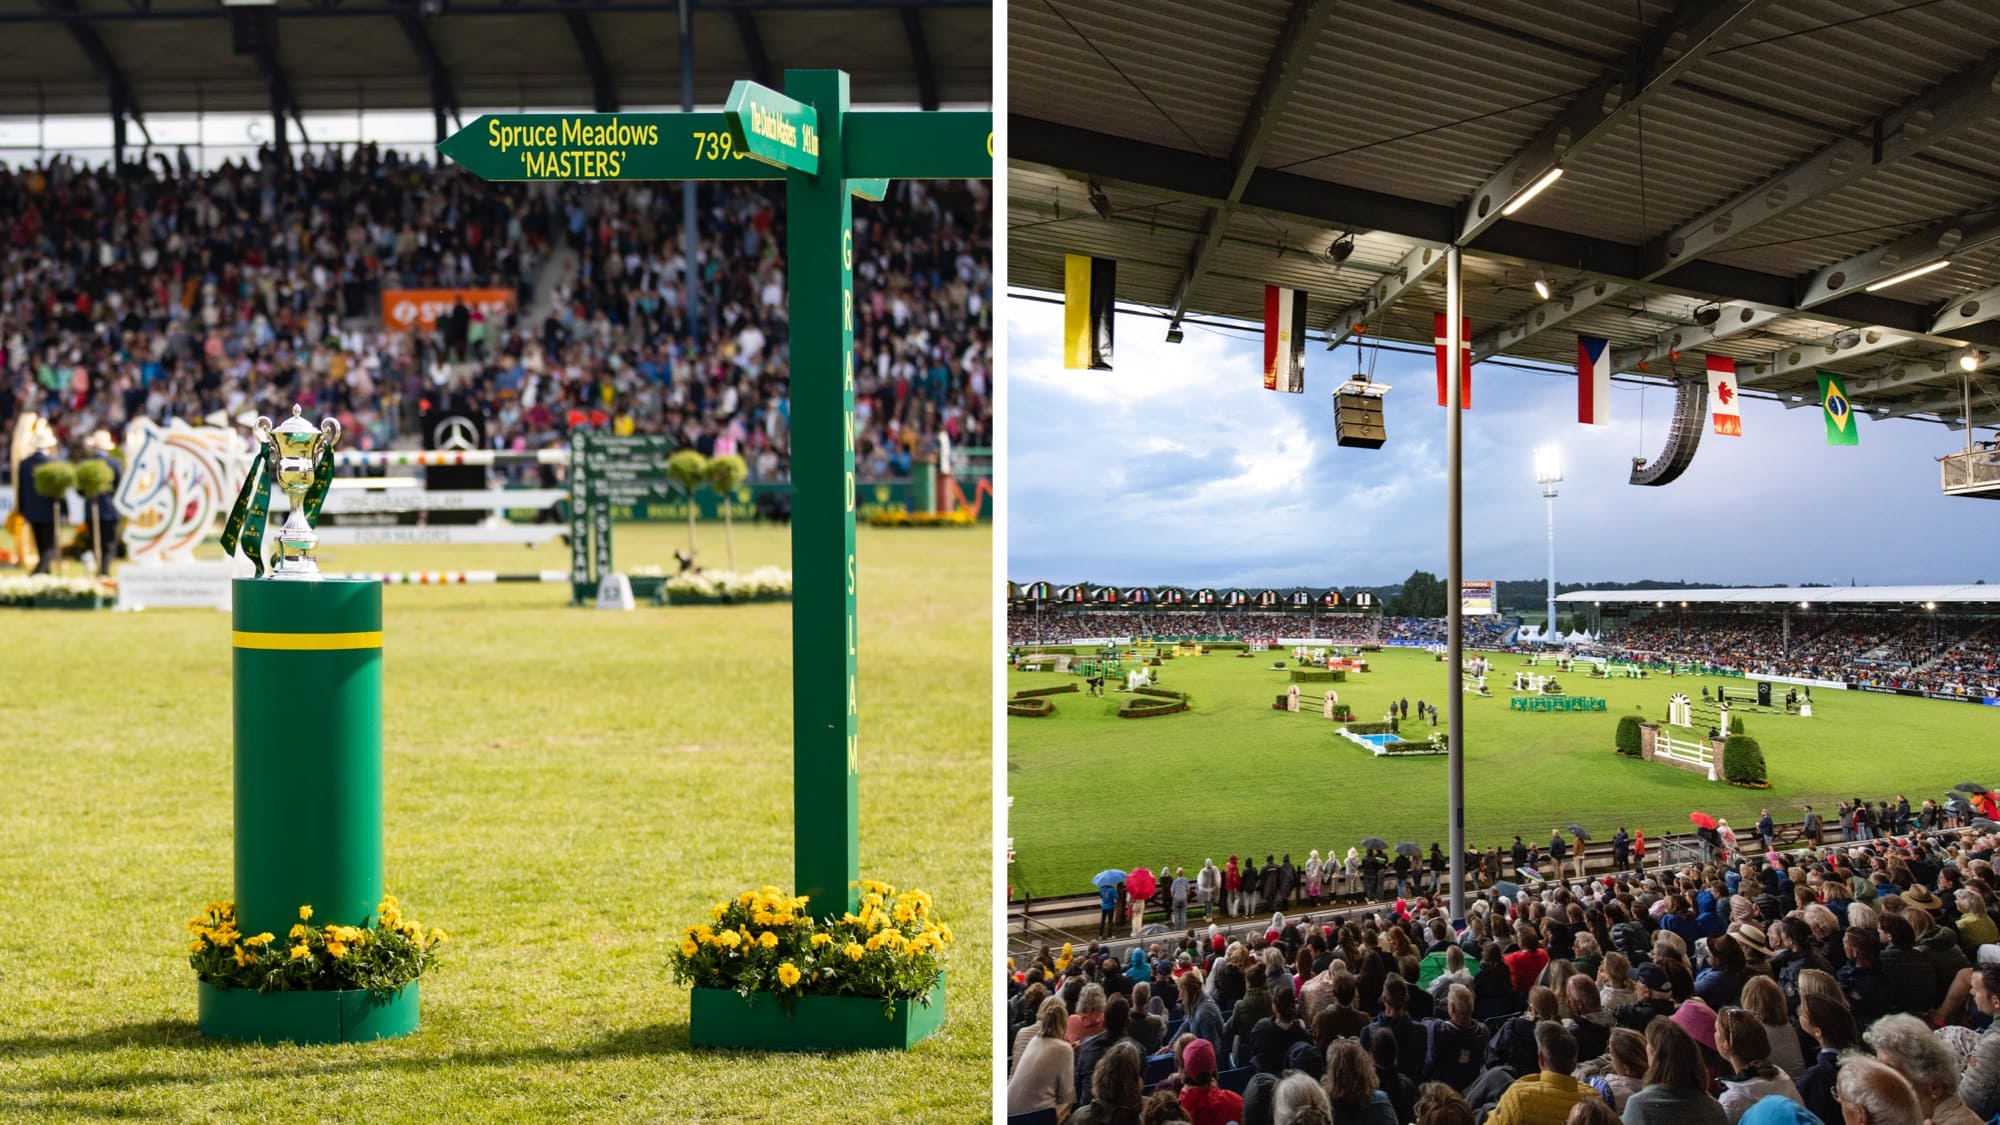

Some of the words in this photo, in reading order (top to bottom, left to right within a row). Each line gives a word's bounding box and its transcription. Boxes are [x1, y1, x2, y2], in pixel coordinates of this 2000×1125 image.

[488, 118, 557, 153] Spruce
[561, 117, 658, 146] Meadows
[693, 131, 744, 160] 739
[843, 229, 855, 512] GRAND
[848, 554, 858, 777] SLAM
